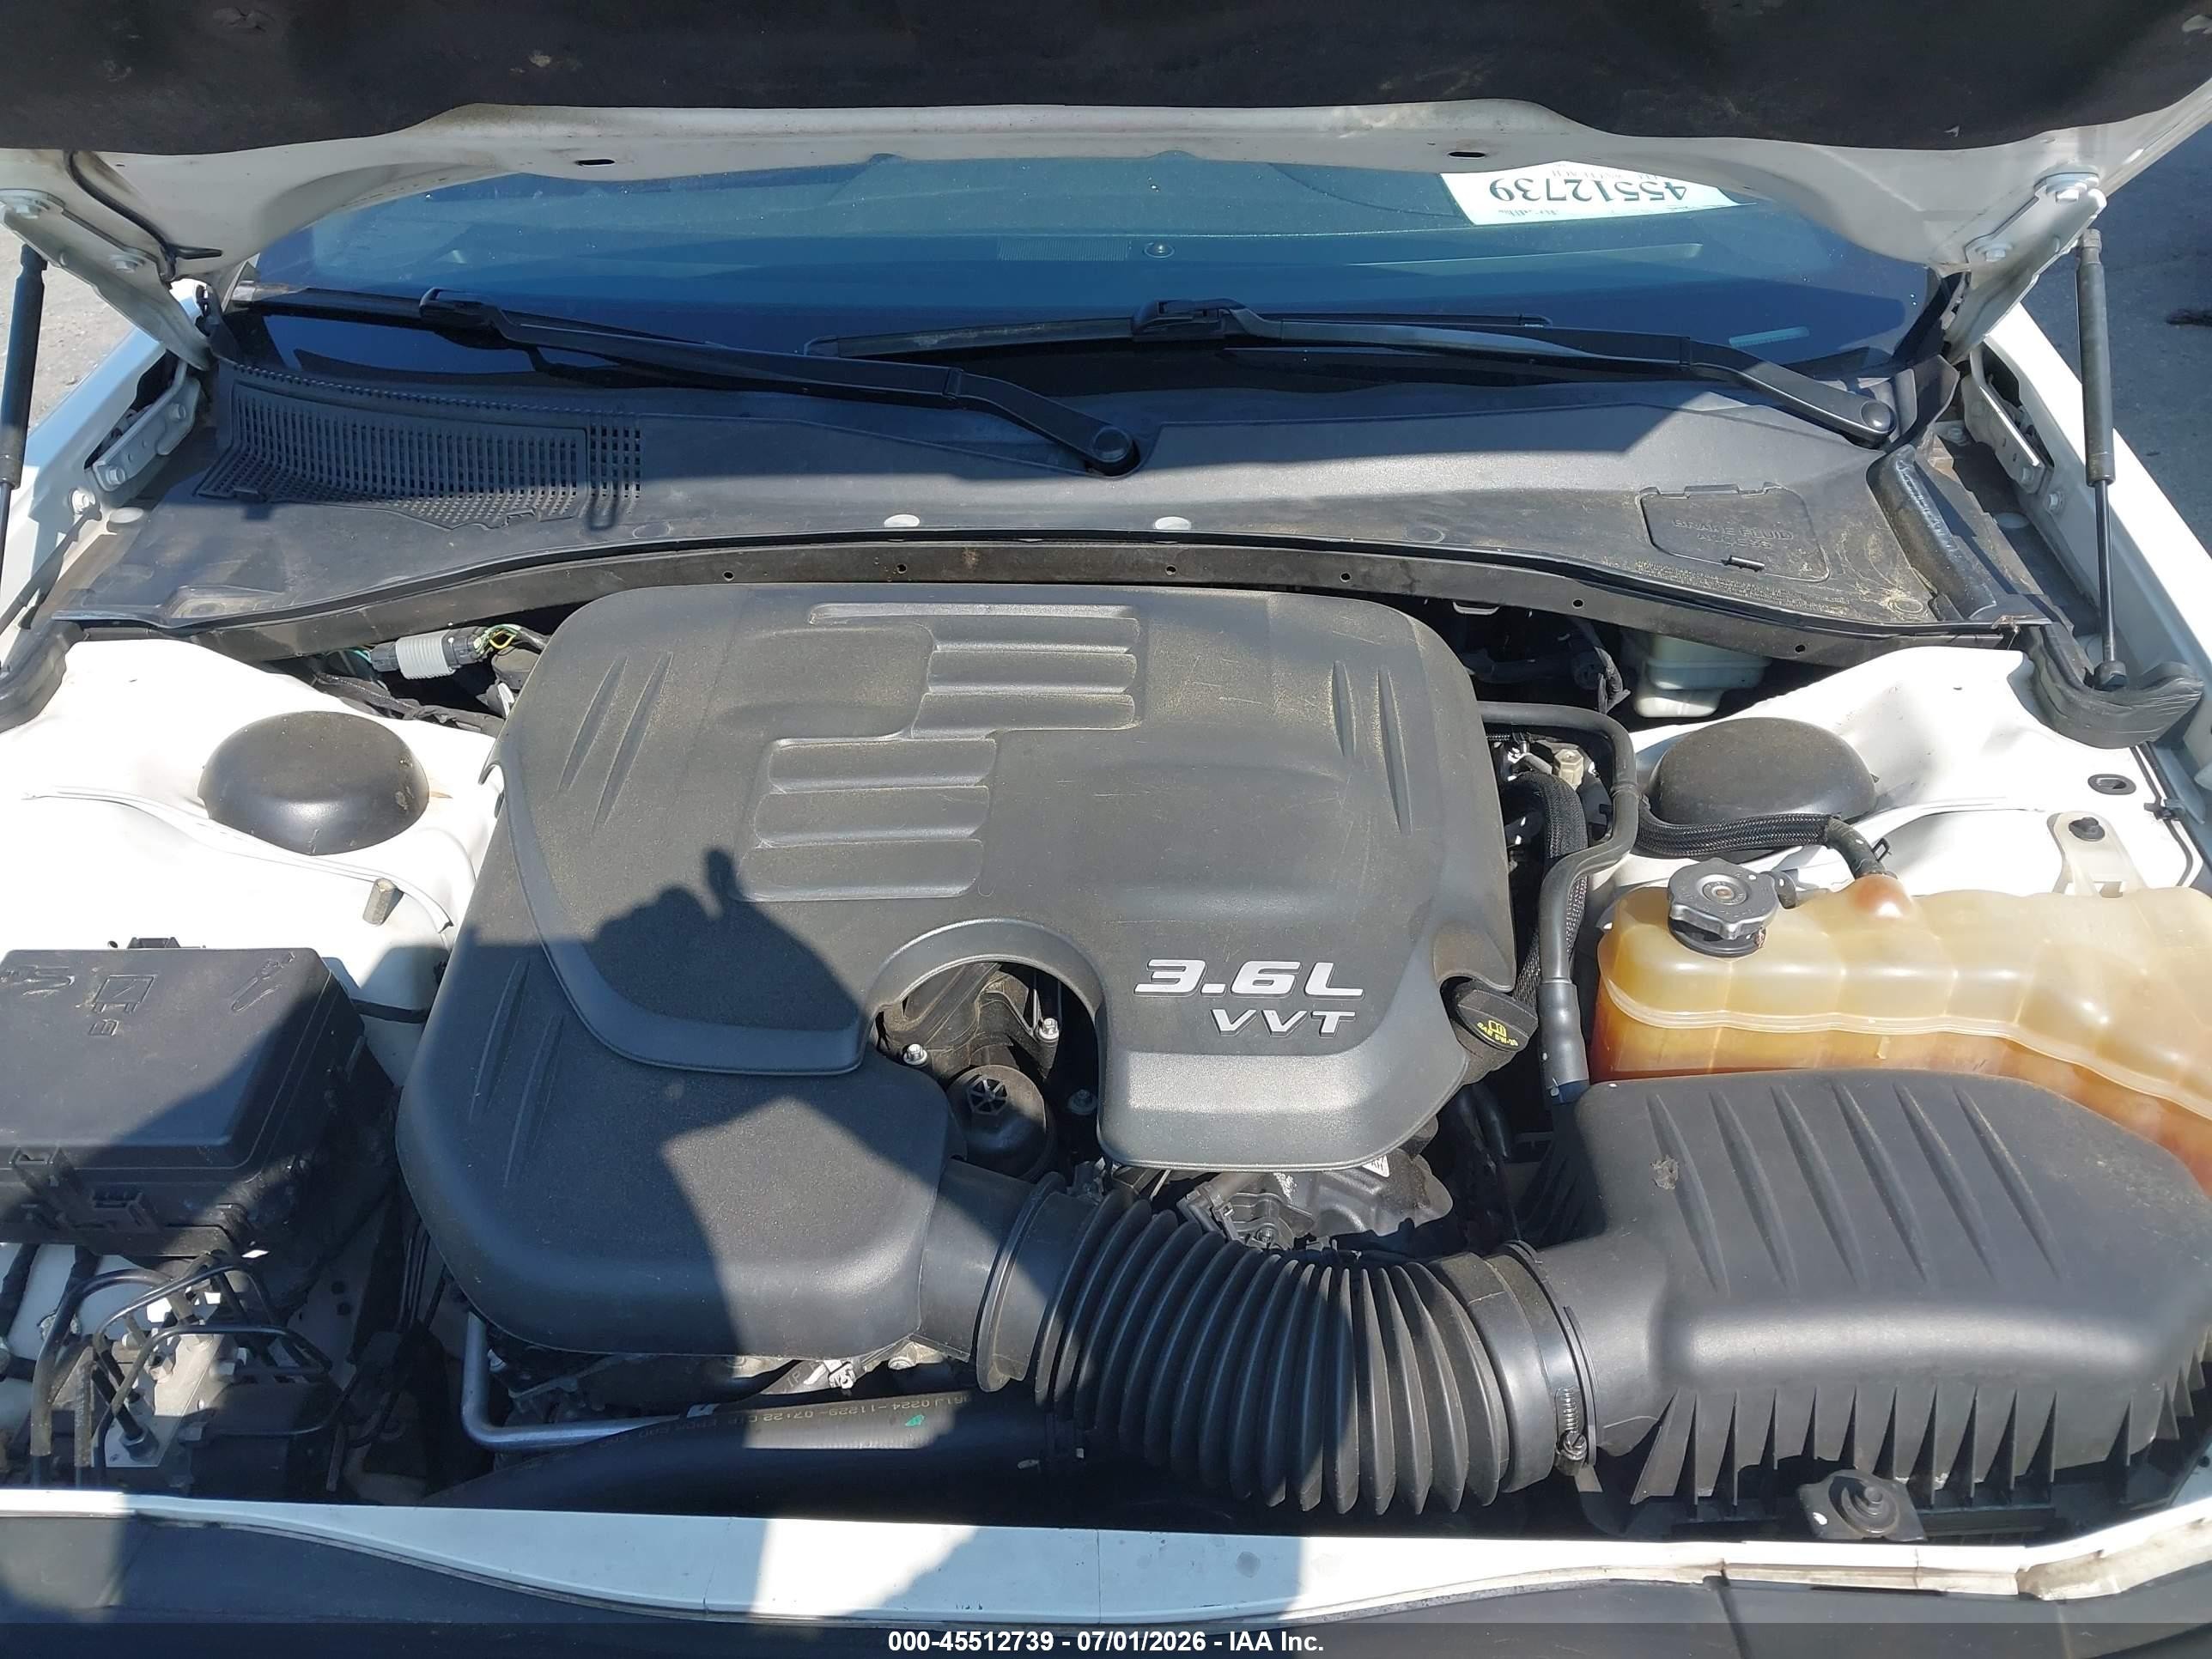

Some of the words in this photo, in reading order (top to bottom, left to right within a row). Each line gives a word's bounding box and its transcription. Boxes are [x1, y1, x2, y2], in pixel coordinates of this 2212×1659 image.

[1490, 178, 1687, 202] 45512739
[1672, 519, 1735, 536] BRAKE
[1739, 526, 1794, 540] FLUID
[1697, 532, 1774, 550] ACCESS
[1133, 959, 1364, 1000] 3.6L
[1211, 1009, 1357, 1038] VVT
[1477, 1022, 1493, 1036] SAE
